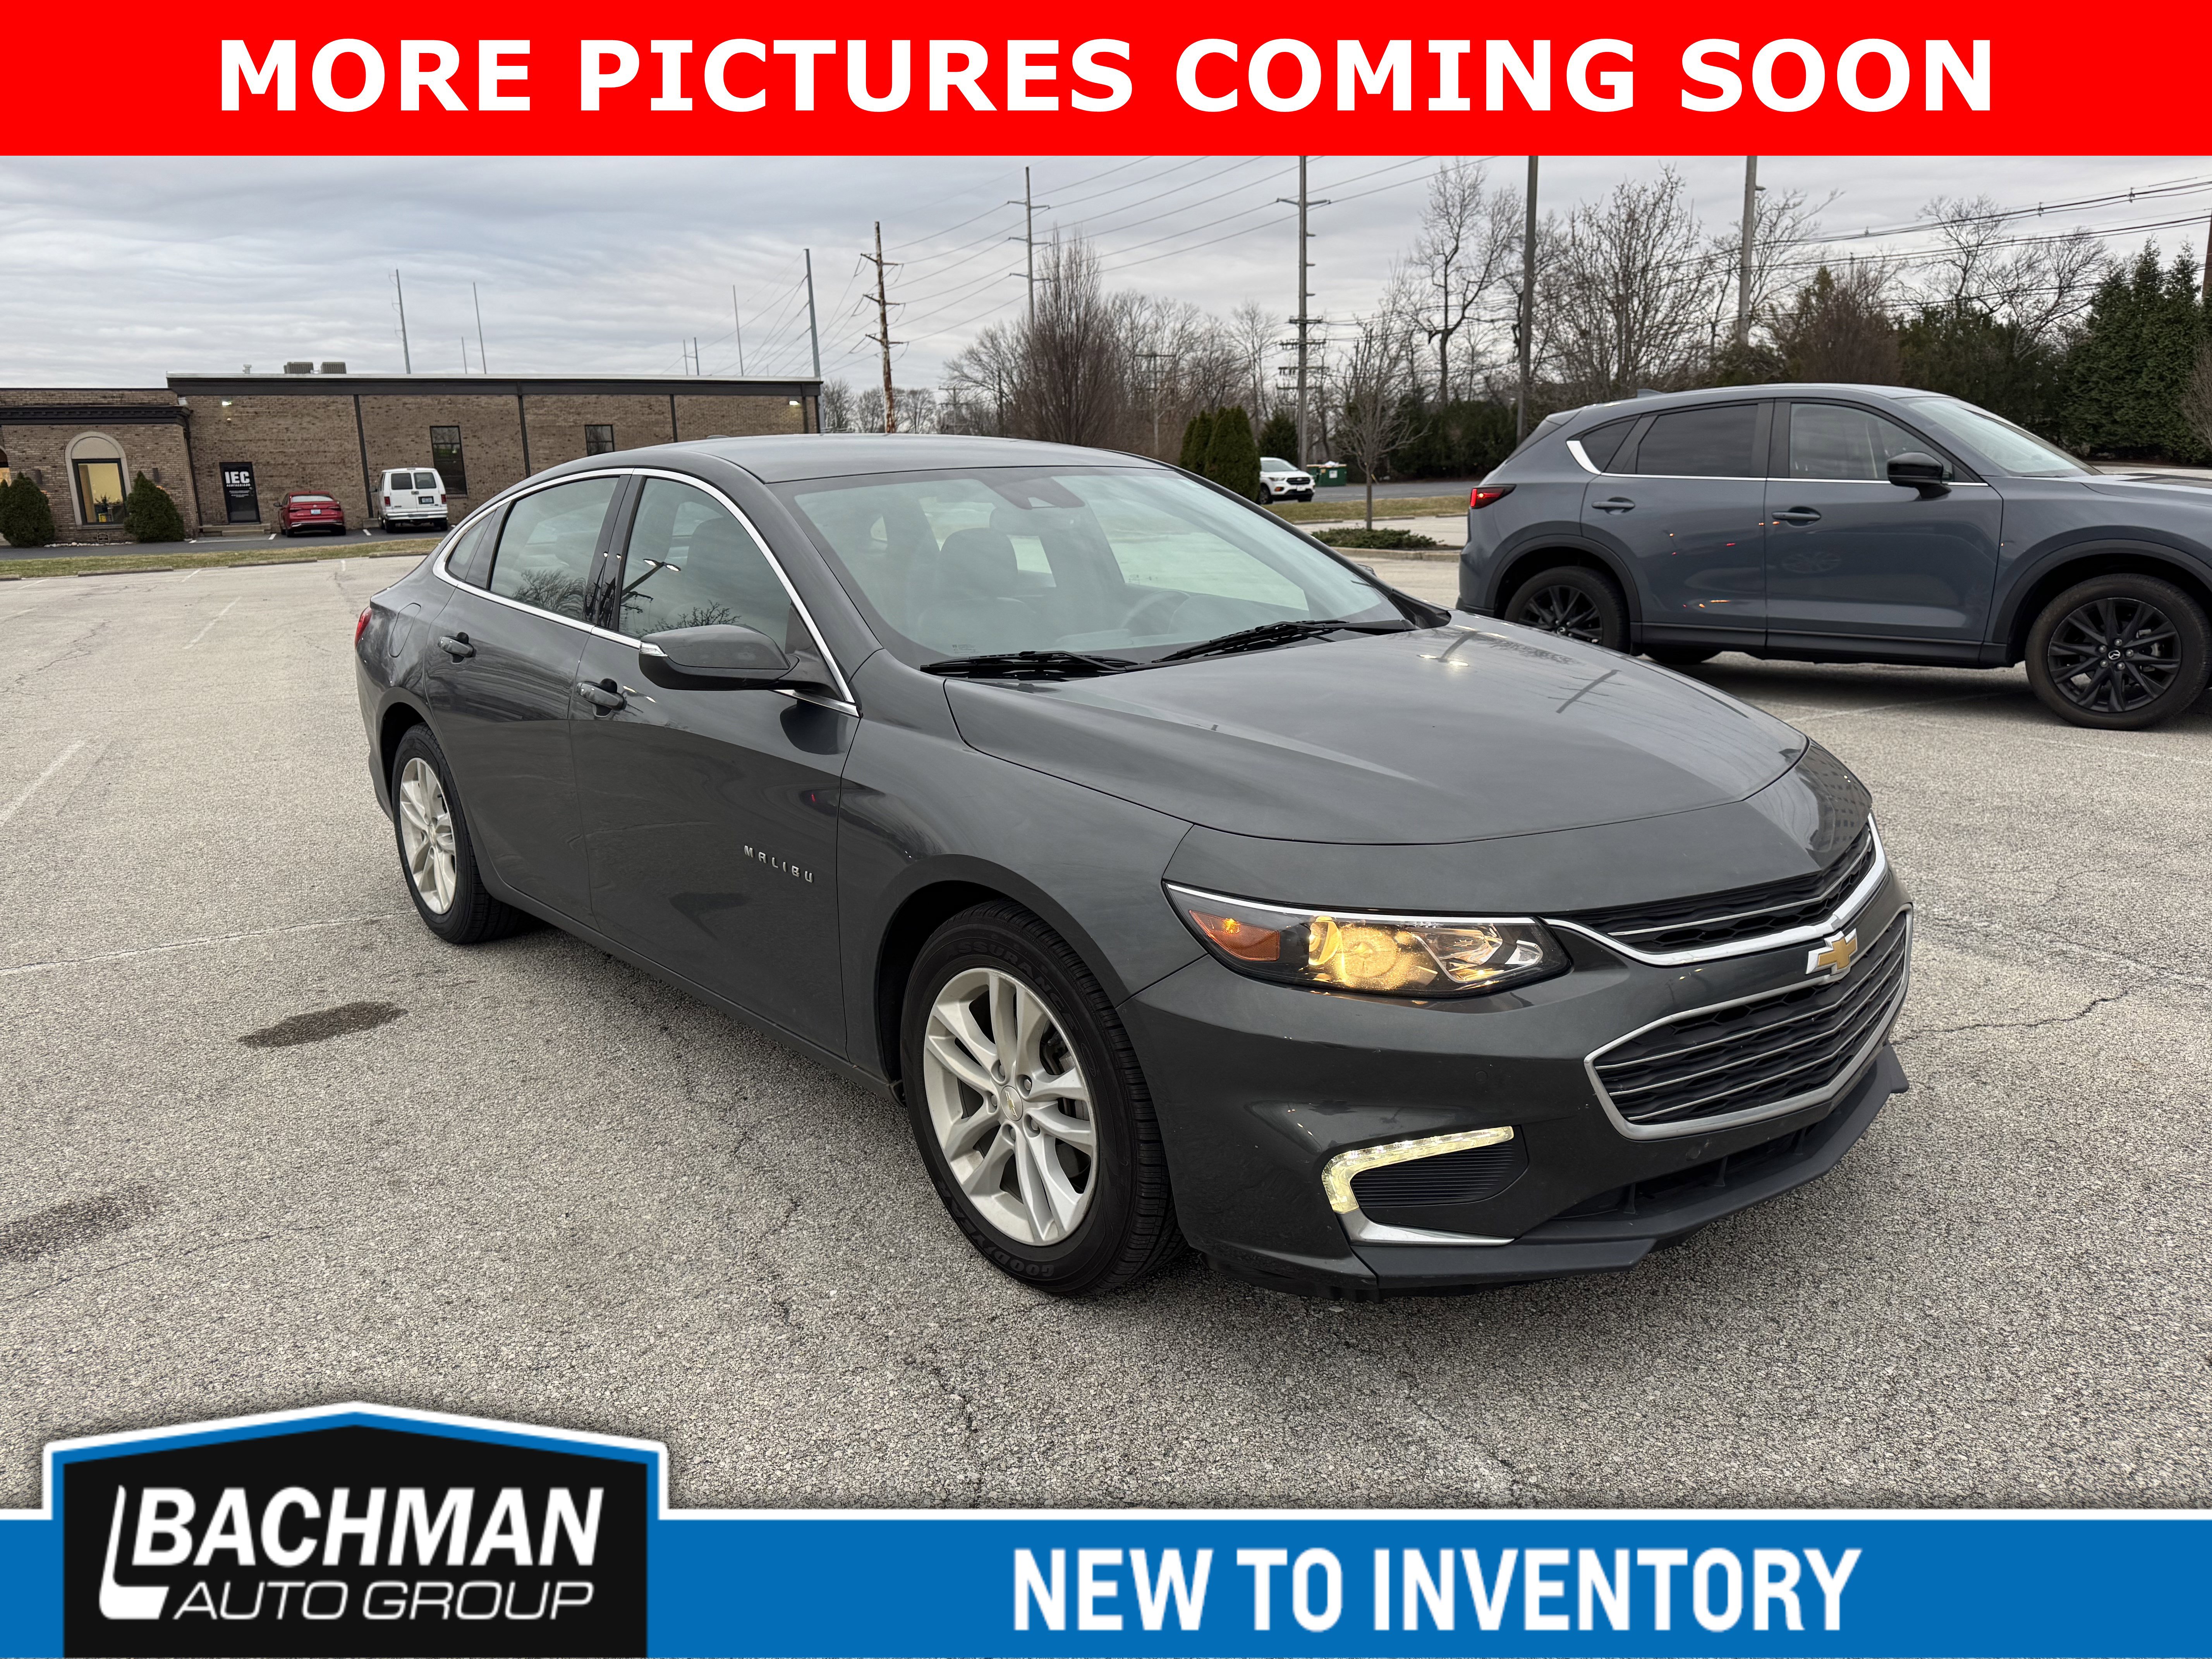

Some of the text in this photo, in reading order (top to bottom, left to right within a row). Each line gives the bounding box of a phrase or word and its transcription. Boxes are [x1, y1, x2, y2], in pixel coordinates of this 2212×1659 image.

[225, 471, 250, 484] IEC
[744, 845, 814, 883] MALIBU
[946, 941, 1079, 1031] ASSURANCE
[936, 1180, 1054, 1277] GOODYEAR
